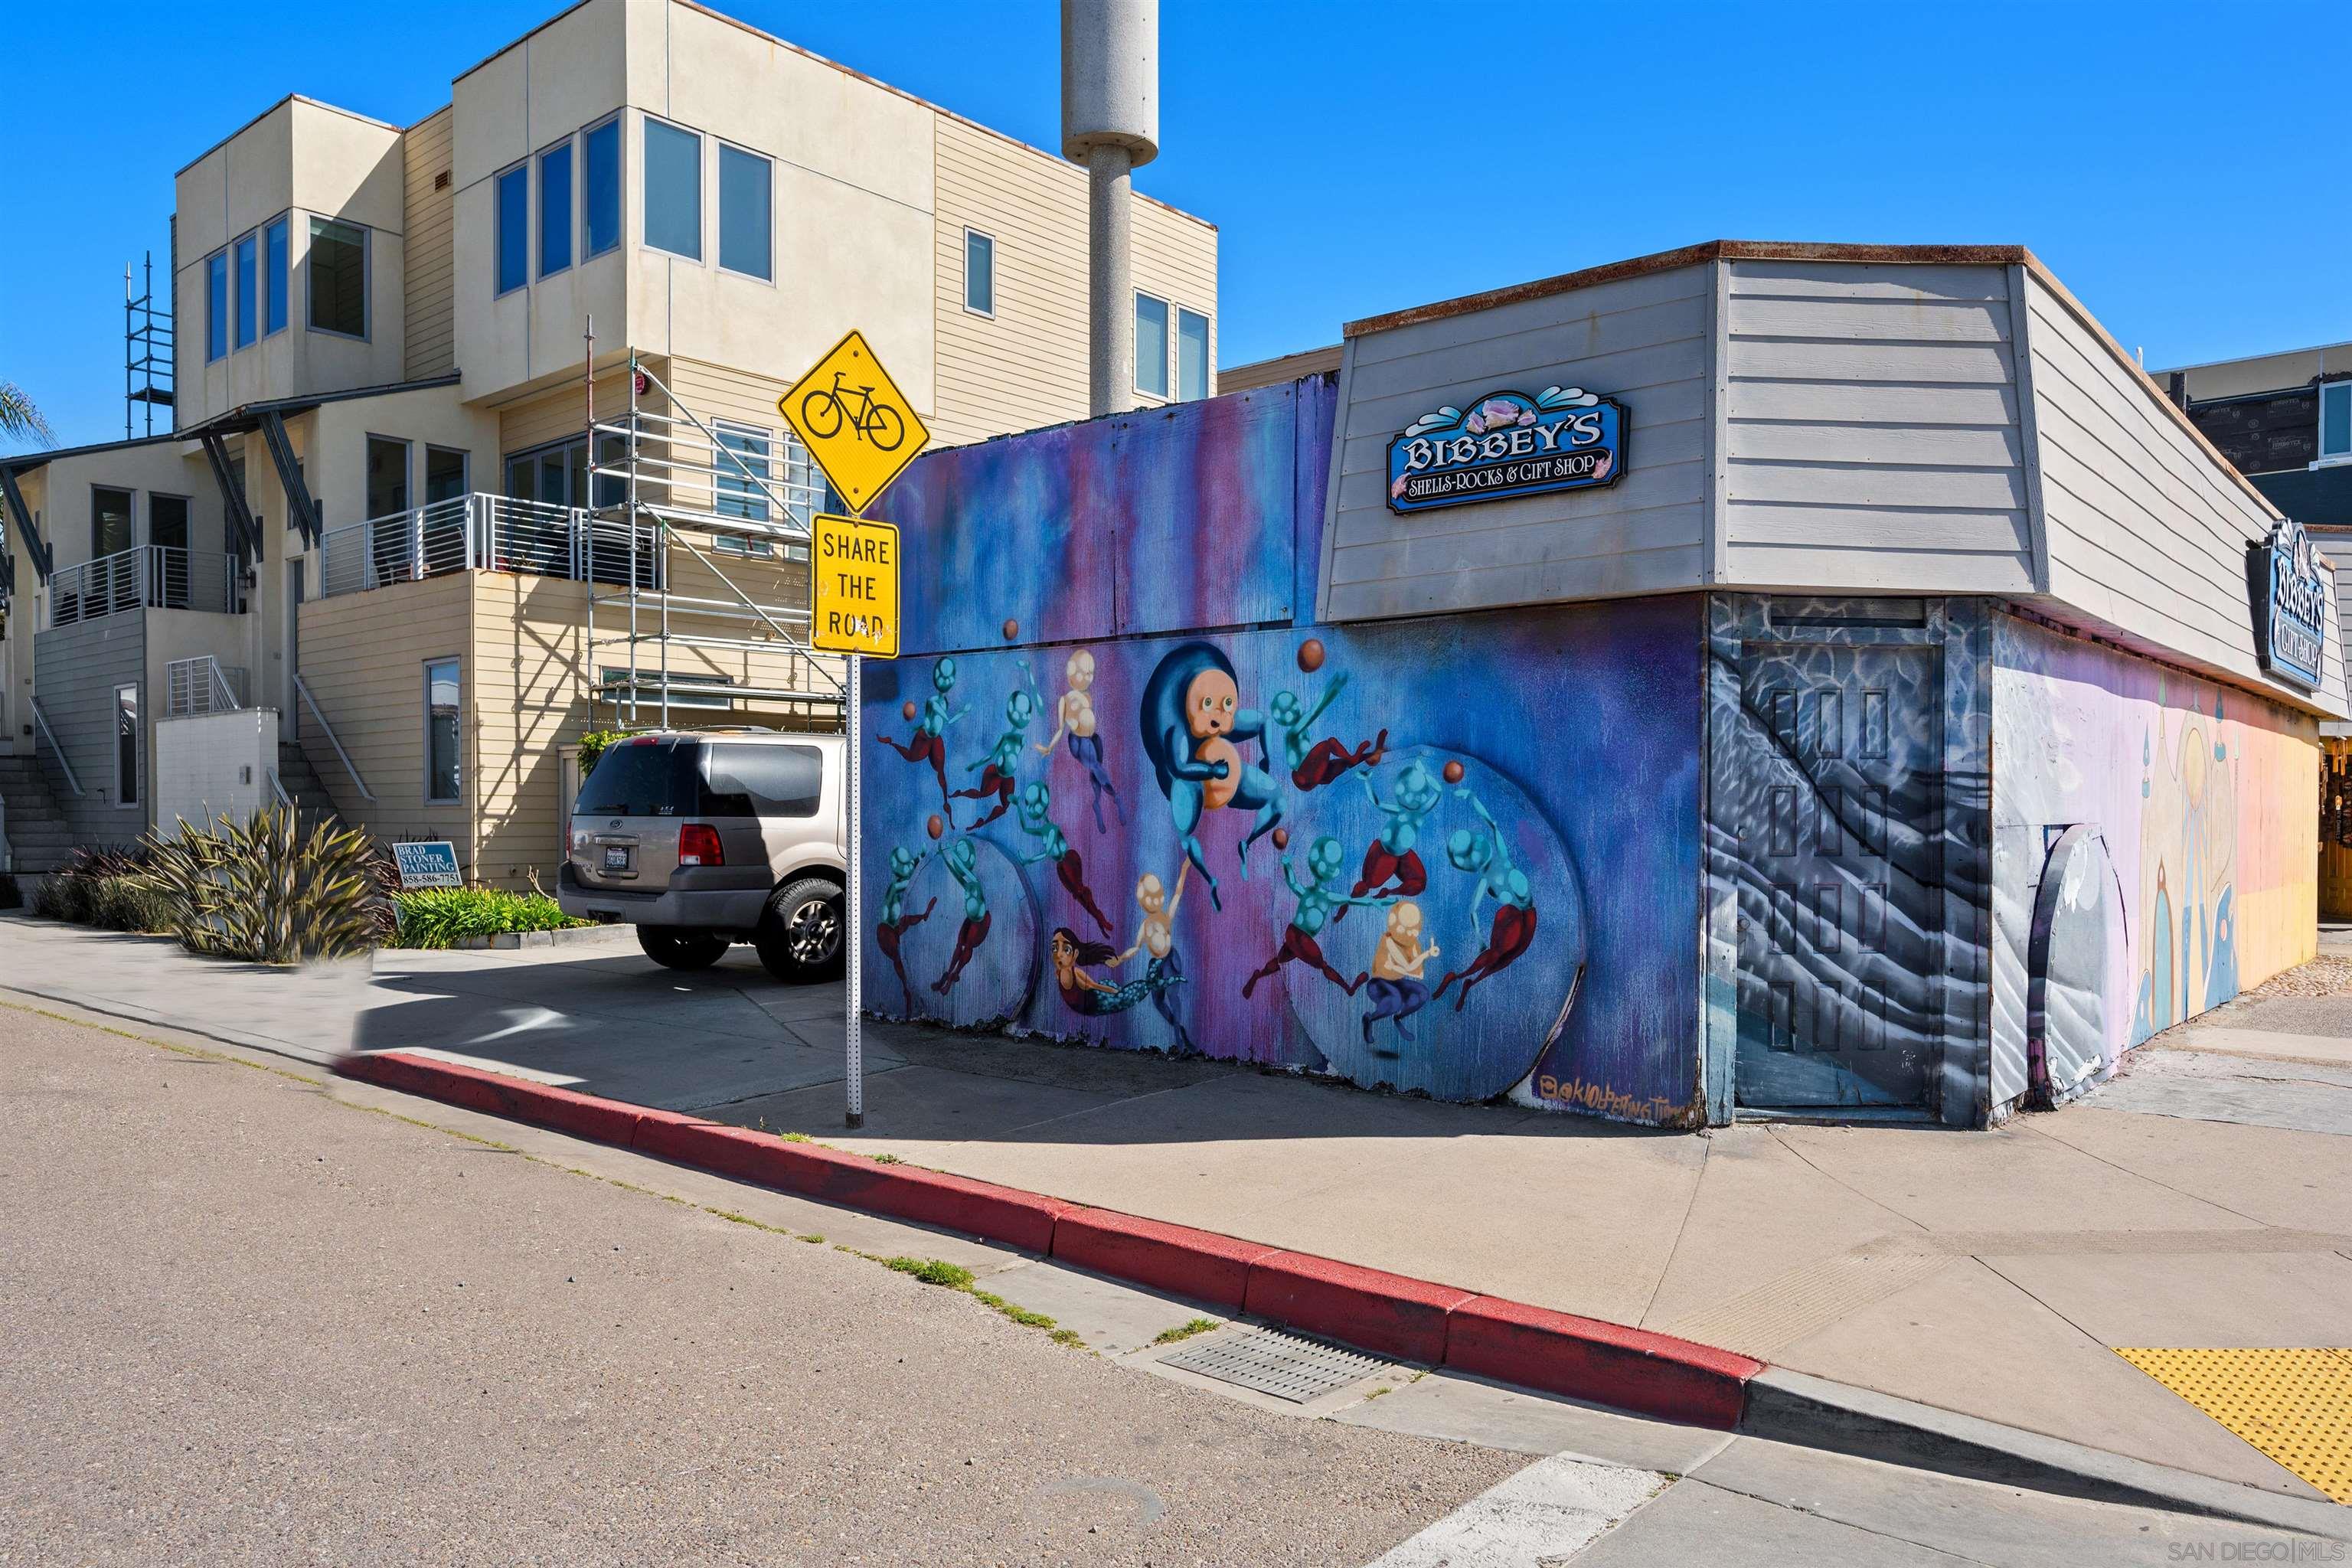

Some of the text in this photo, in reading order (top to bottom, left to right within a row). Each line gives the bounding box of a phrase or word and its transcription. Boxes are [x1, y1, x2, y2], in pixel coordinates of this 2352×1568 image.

[1403, 412, 1601, 470] BIBBEY'S
[1408, 455, 1595, 497] SHELLS-ROCKS & GIFT SHOP
[823, 533, 889, 564] SHARE
[837, 573, 876, 601] THE
[2276, 556, 2323, 630] BIBBEY'S
[828, 611, 884, 638] ROAD
[2281, 624, 2317, 667] GIFT SHOP
[397, 845, 426, 855] BRAD
[400, 854, 444, 864] STONER
[403, 862, 454, 873] PAINTING
[403, 874, 459, 884] 858-586-7751
